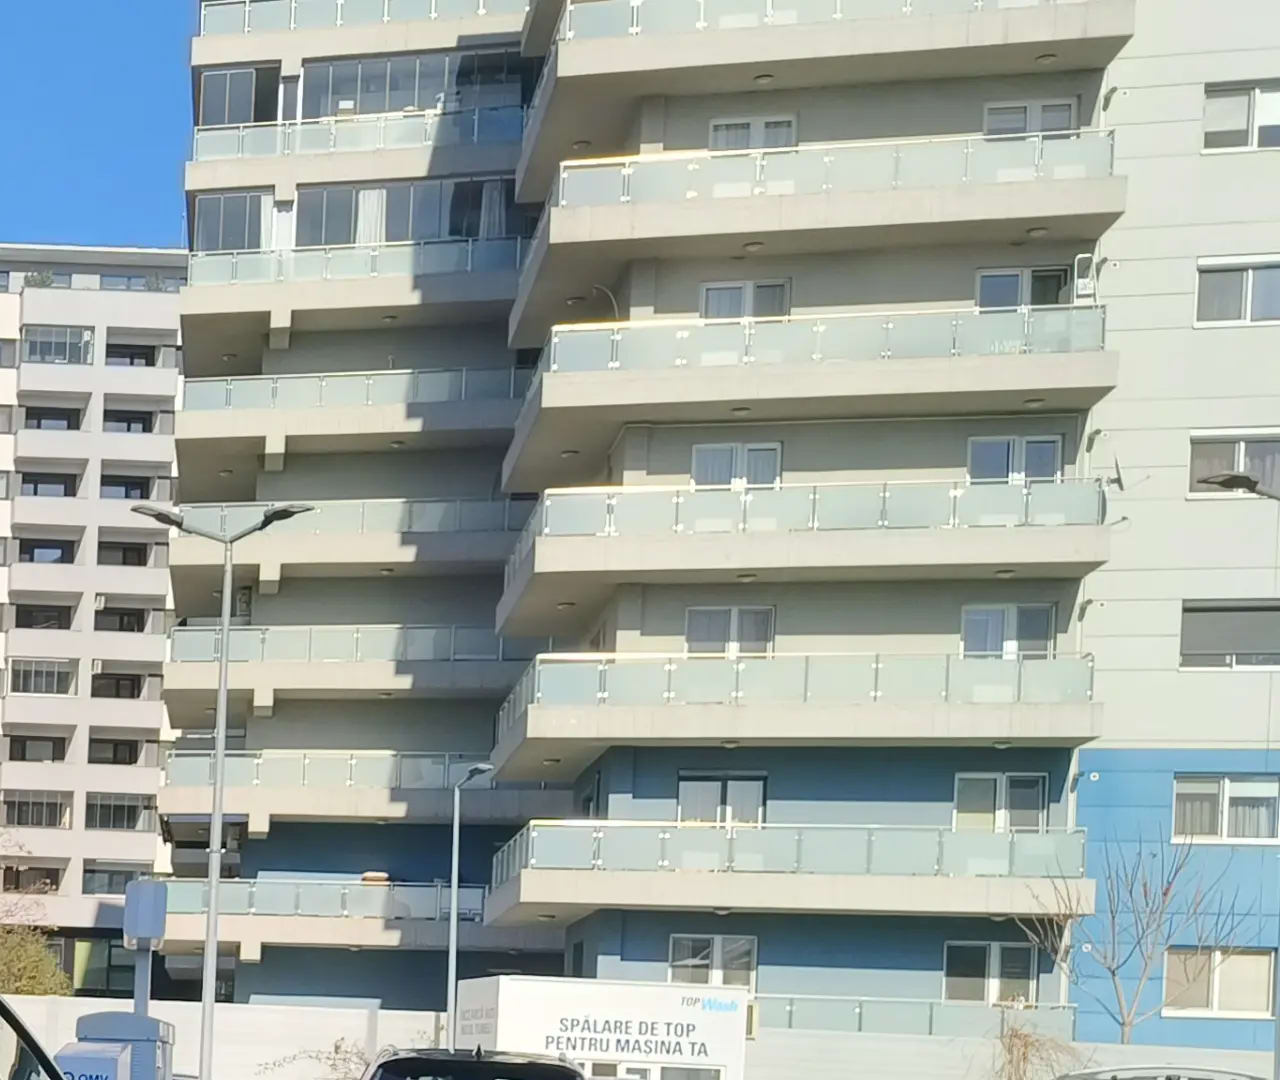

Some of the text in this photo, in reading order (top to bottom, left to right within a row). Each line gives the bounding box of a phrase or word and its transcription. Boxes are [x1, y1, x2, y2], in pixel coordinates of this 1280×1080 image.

[559, 1015, 697, 1038] SPĂLARE DE TOP
[544, 1035, 611, 1053] PENTRU
[689, 1041, 709, 1057] TA
